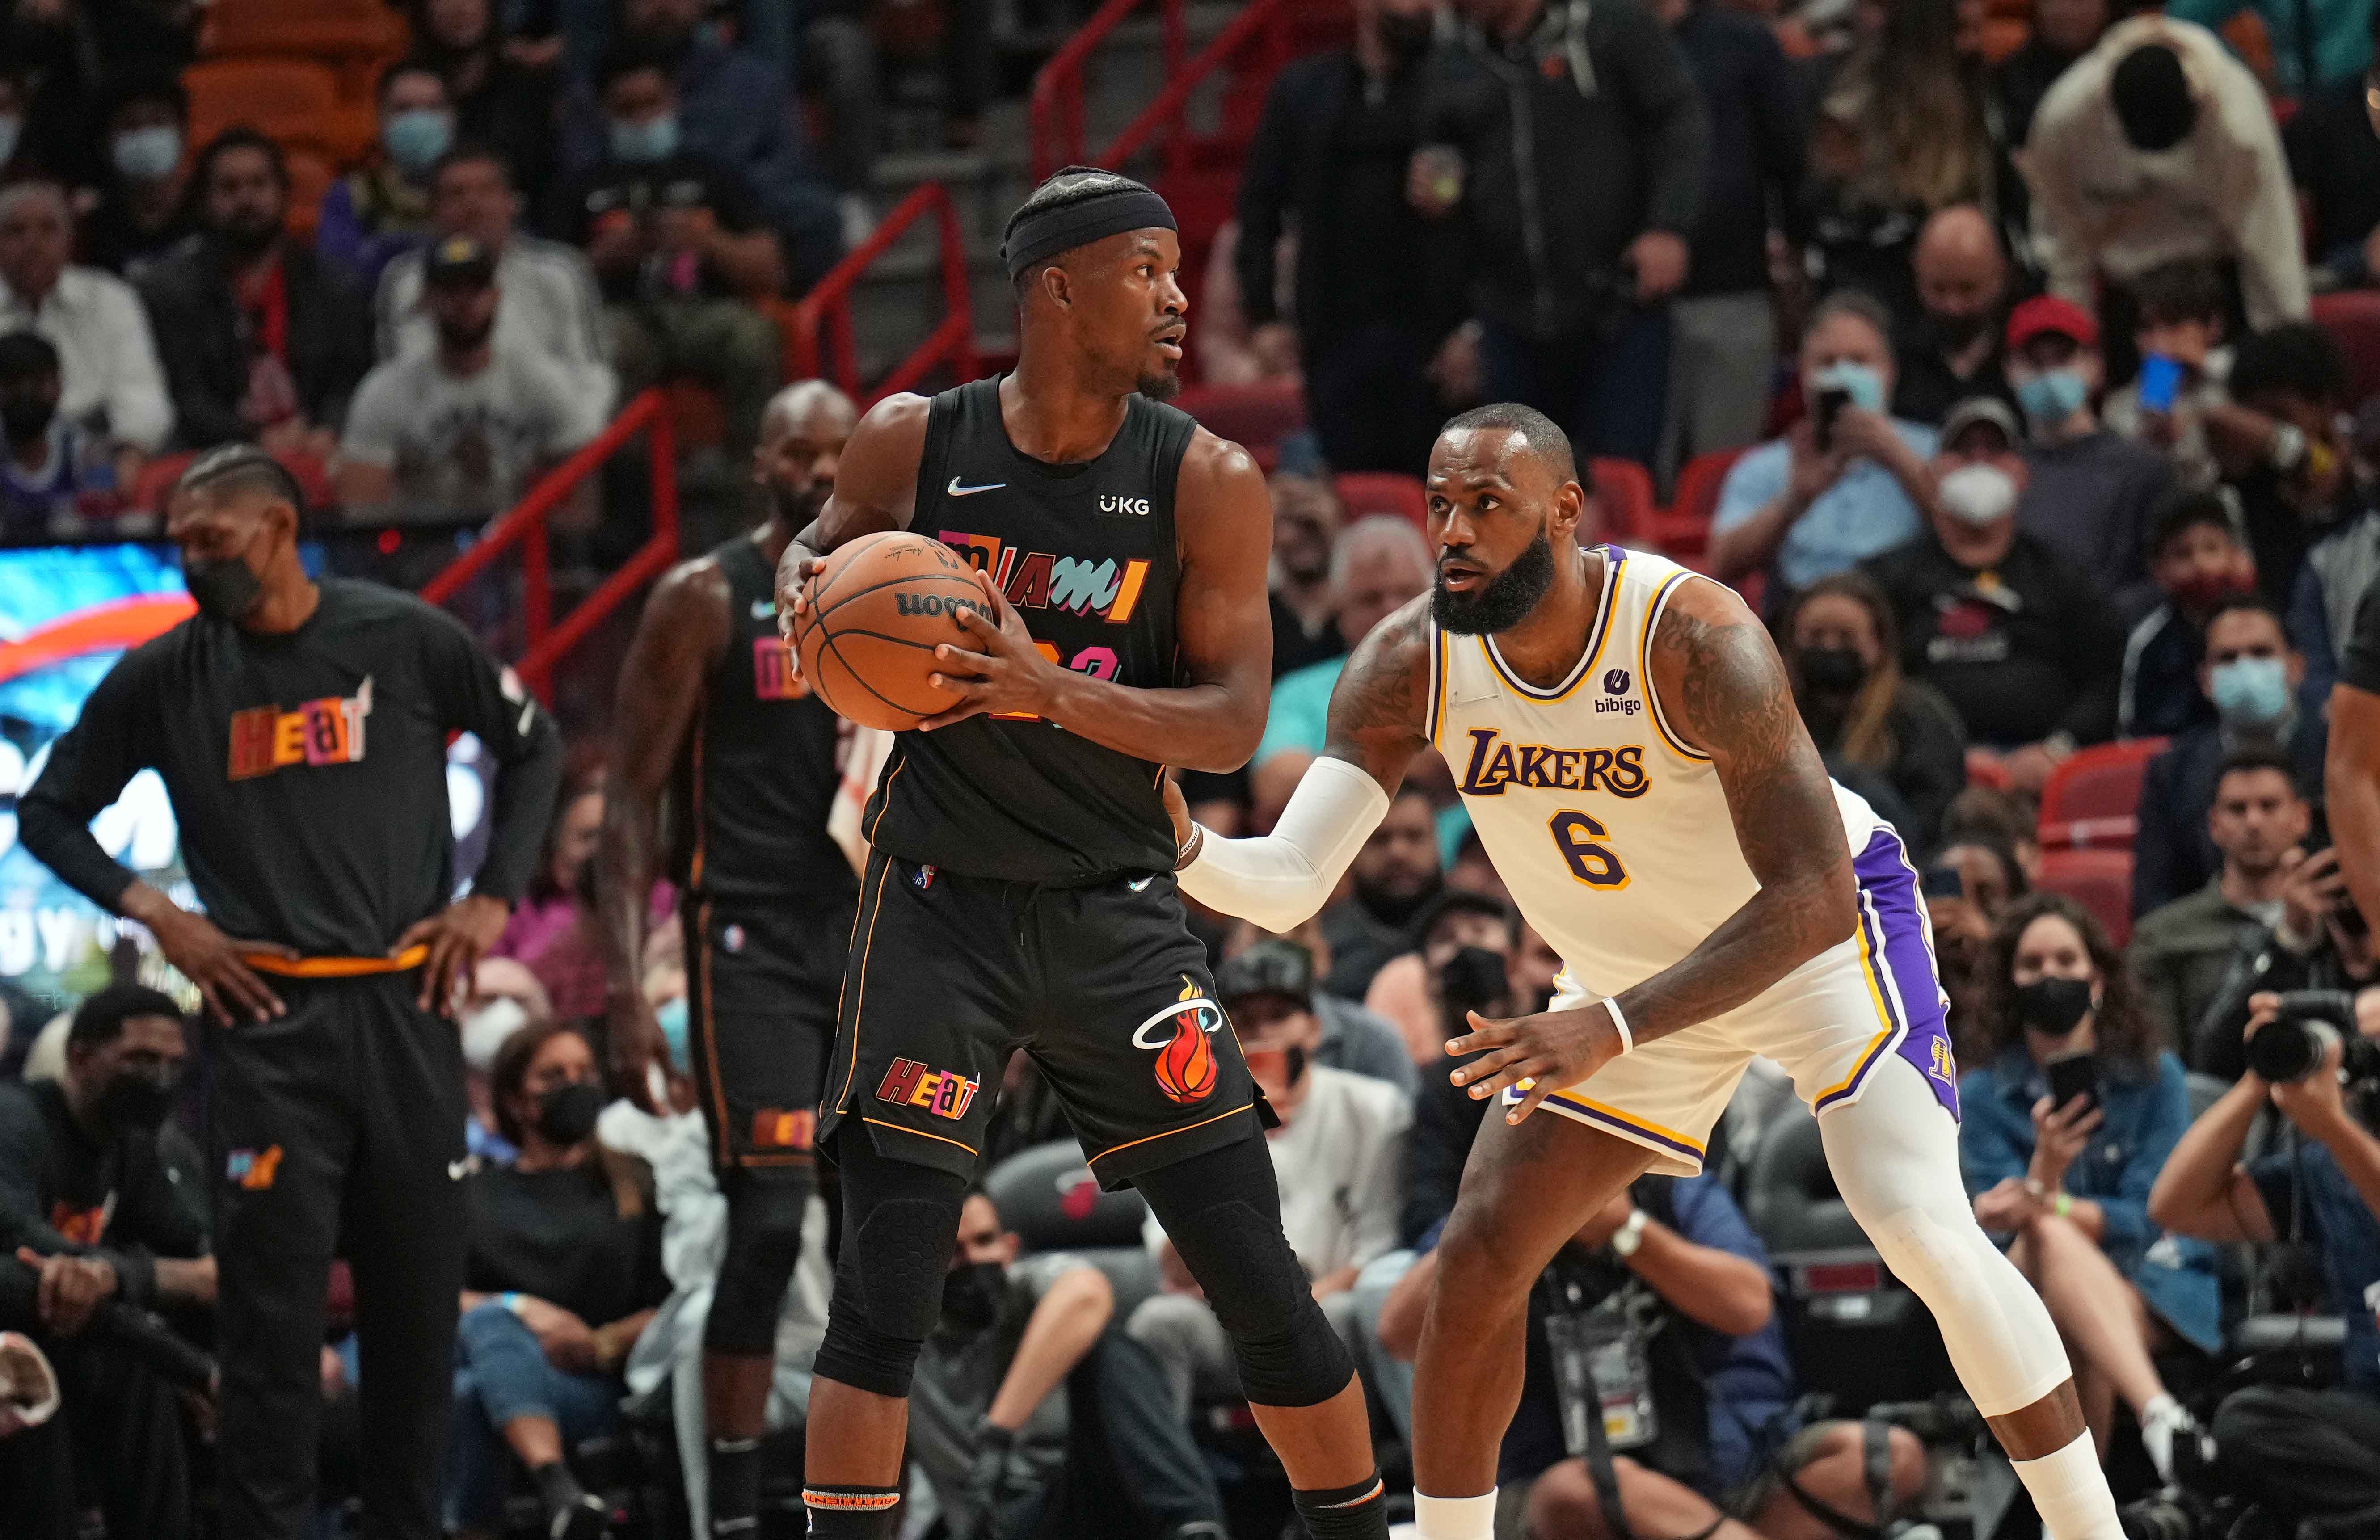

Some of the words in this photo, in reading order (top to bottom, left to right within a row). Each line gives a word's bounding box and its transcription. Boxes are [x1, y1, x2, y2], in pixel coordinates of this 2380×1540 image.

[1595, 697, 1641, 715] bibigo
[1456, 727, 1652, 799] LAKERS
[1546, 808, 1631, 891] 6
